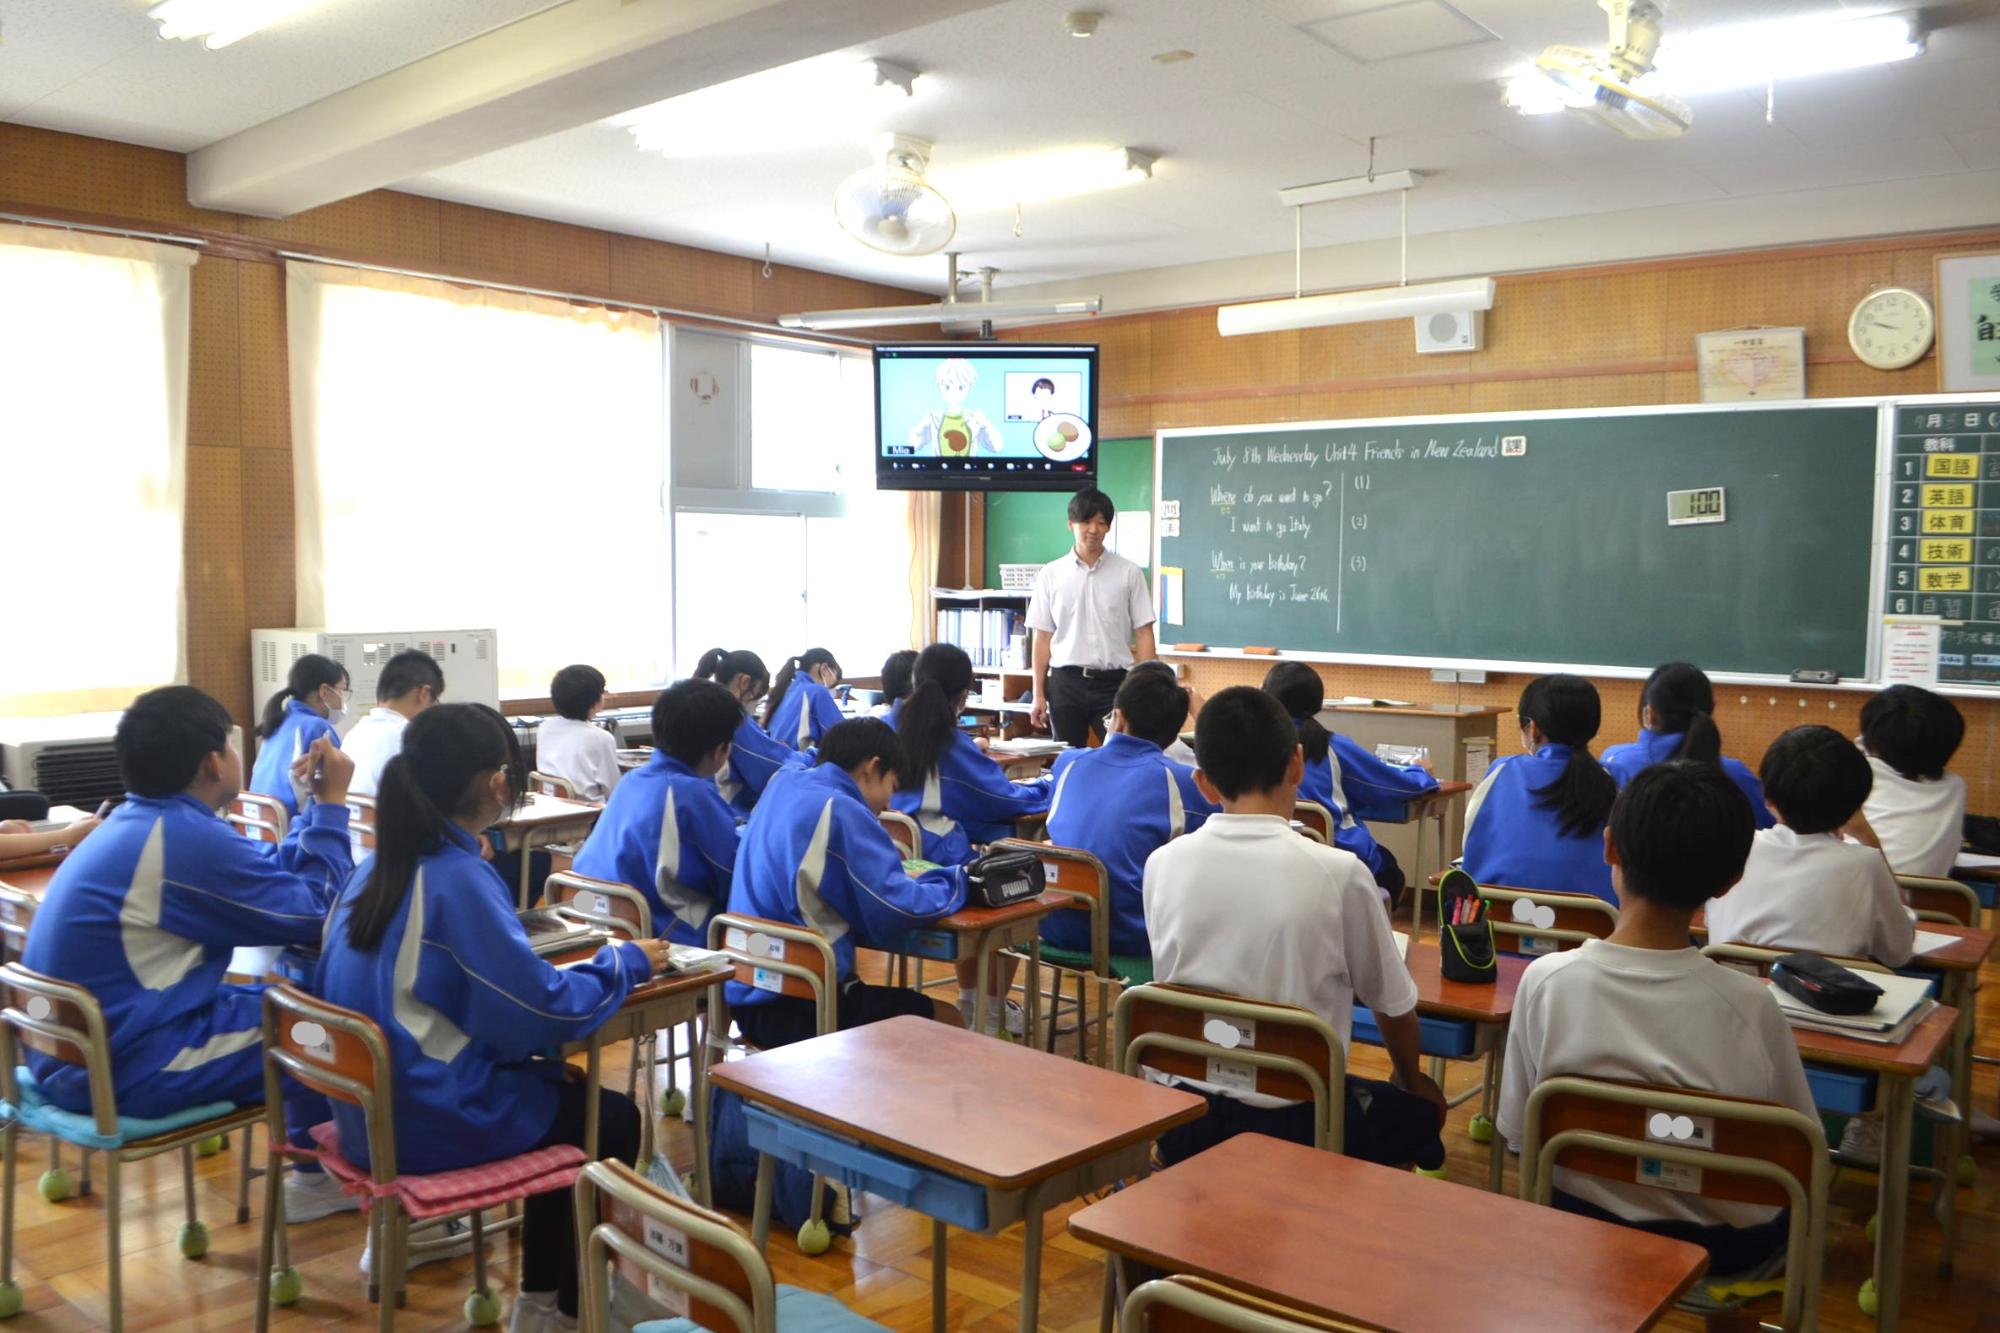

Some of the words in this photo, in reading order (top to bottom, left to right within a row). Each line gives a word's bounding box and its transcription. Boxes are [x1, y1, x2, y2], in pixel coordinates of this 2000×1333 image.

[1211, 446, 1236, 471] July
[1243, 446, 1261, 464] 8th
[1267, 443, 1319, 468] Wednesday
[1364, 439, 1402, 461] Friends
[1410, 446, 1420, 459] in
[1424, 438, 1450, 459] New
[1452, 436, 1499, 458] Zealand
[1904, 461, 1913, 476] 1
[1933, 458, 1971, 475] 国語
[1354, 474, 1370, 490] (1)
[1210, 483, 1236, 504] Where
[1243, 485, 1254, 503] do
[1257, 494, 1273, 506] you
[1279, 487, 1296, 503] want
[1302, 490, 1310, 503] to
[1902, 489, 1913, 504] 2
[1928, 489, 1965, 505] 英語
[1230, 516, 1236, 533] I
[1242, 516, 1261, 533] want
[1265, 520, 1273, 533] to
[1276, 523, 1286, 539] go
[1351, 514, 1367, 530] (2)
[1900, 516, 1911, 531] 3
[1929, 515, 1966, 530] 体育
[1899, 543, 1910, 558] 4
[1927, 544, 1964, 559] 技術
[1210, 550, 1234, 570] When
[1239, 557, 1246, 569] is
[1249, 561, 1265, 574] your
[1351, 556, 1366, 571] (3)
[1897, 570, 1909, 585] 5
[1926, 572, 1963, 588] 数学
[1229, 584, 1241, 606] My
[1246, 583, 1275, 607] birthday
[1279, 590, 1286, 600] is
[1289, 584, 1309, 602] June
[1896, 599, 1907, 613] 6
[1001, 879, 1030, 898] PUMA
